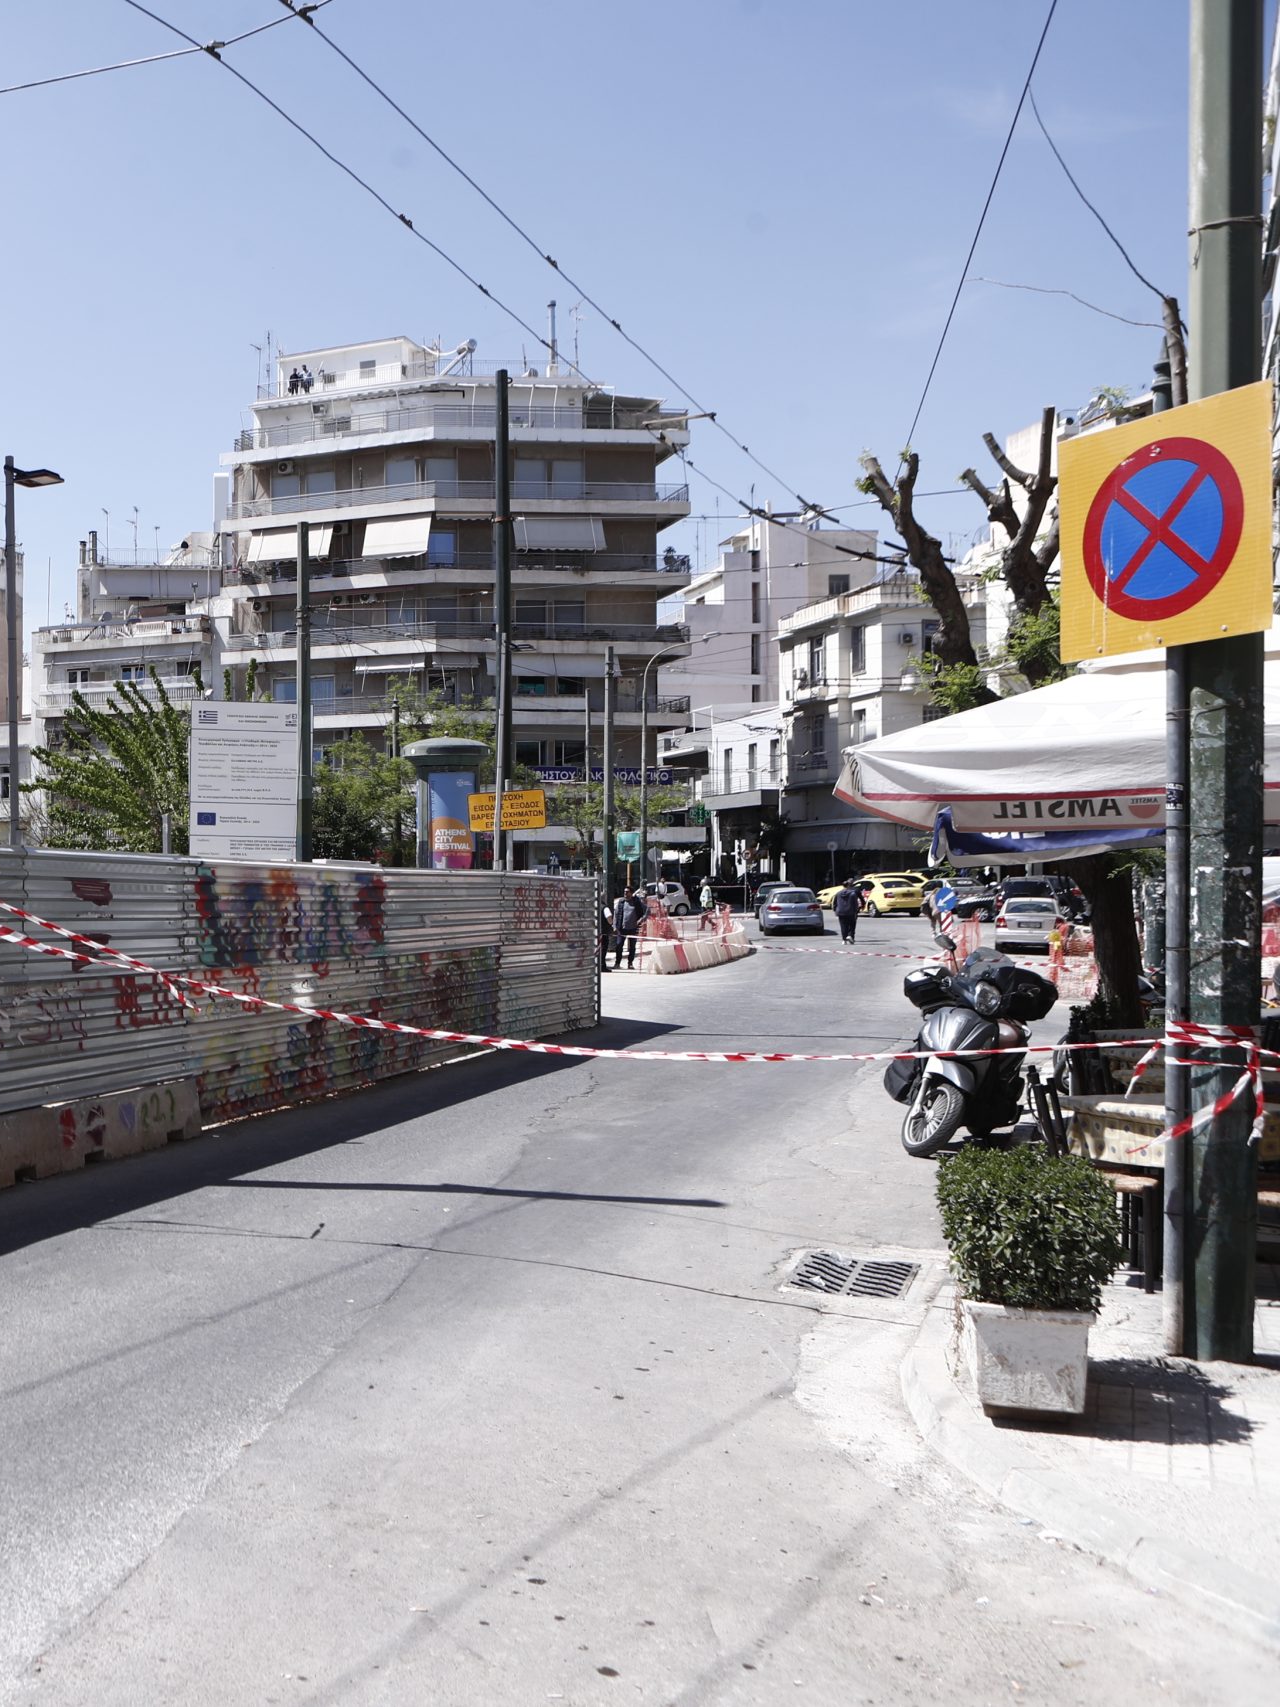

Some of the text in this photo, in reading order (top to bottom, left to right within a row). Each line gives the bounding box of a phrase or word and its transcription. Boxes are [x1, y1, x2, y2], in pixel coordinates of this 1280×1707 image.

[488, 794, 524, 802] ΠΡΣΟΧΗ
[510, 801, 540, 809] ΕΞΟΔΟΣ
[503, 810, 544, 819] ΟΧΗΜΑΤΩΝ
[485, 820, 530, 829] ΕΡΟΤΑΞΙΟΥ
[434, 842, 471, 850] FESTIVAL
